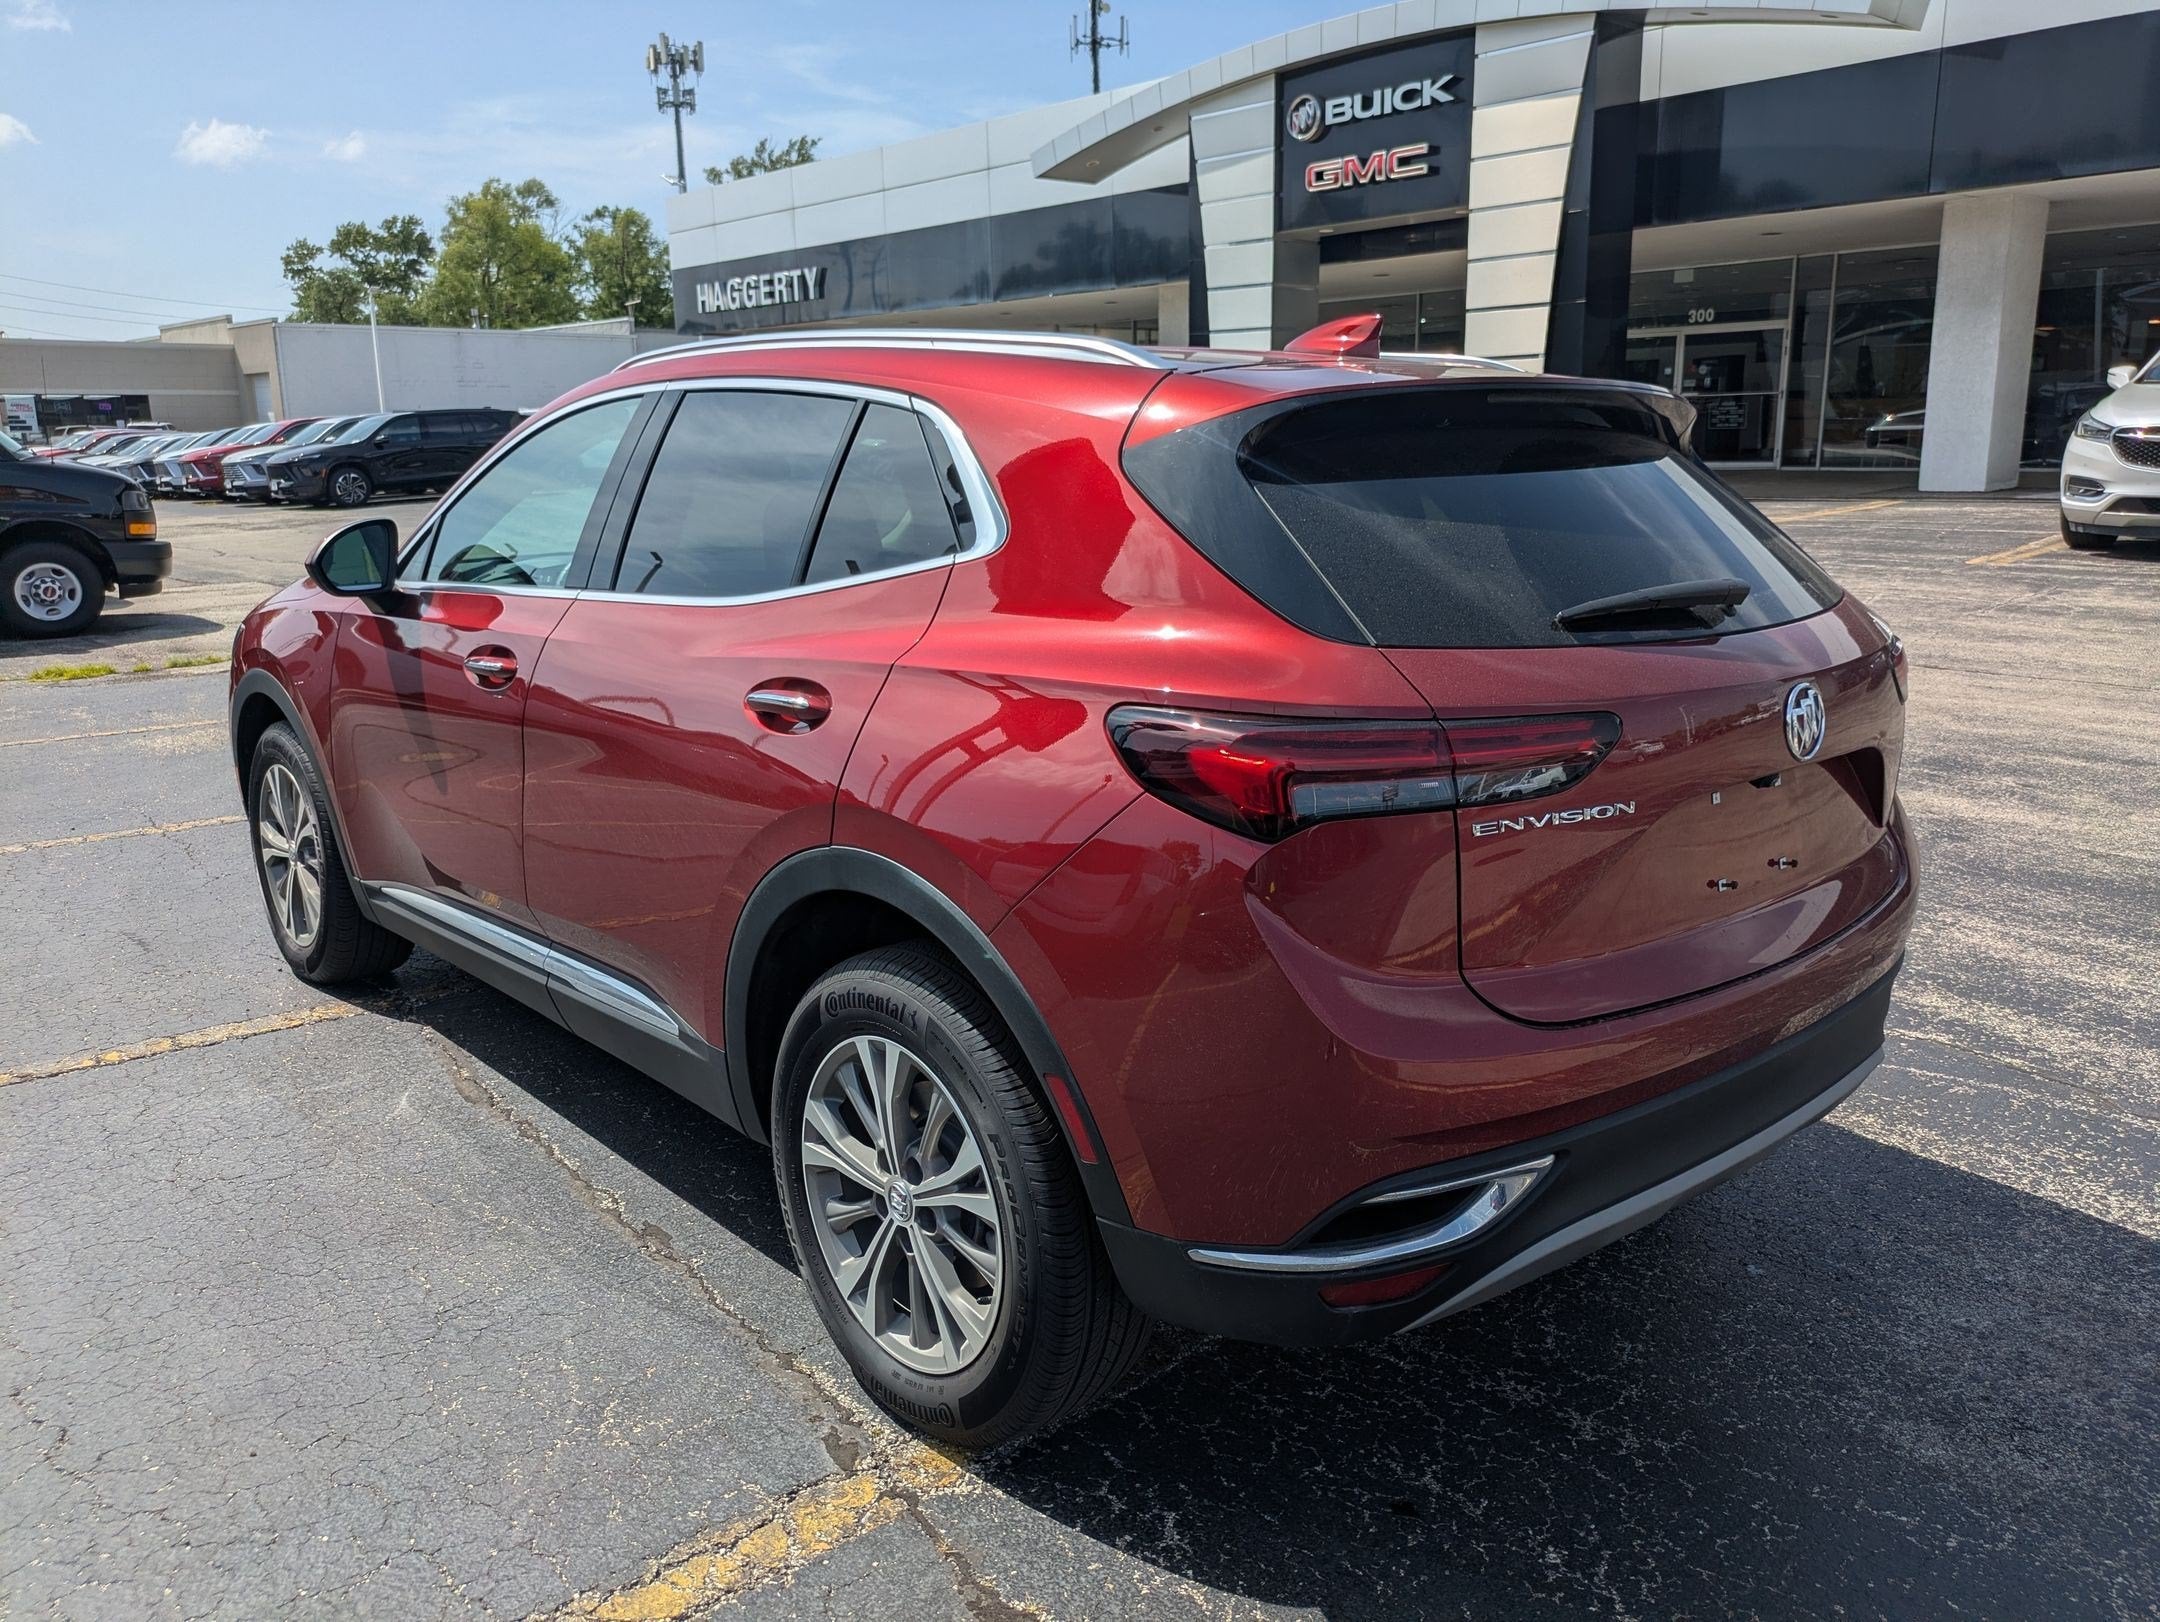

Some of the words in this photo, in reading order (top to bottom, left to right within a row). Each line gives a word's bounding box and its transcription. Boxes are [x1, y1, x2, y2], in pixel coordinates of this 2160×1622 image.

[1325, 73, 1456, 126] BUICK
[1305, 143, 1429, 192] GMC
[696, 266, 817, 314] HAGGERTY
[1688, 308, 1715, 323] 300
[1472, 801, 1636, 837] ENVISION
[824, 986, 907, 1024] Continental
